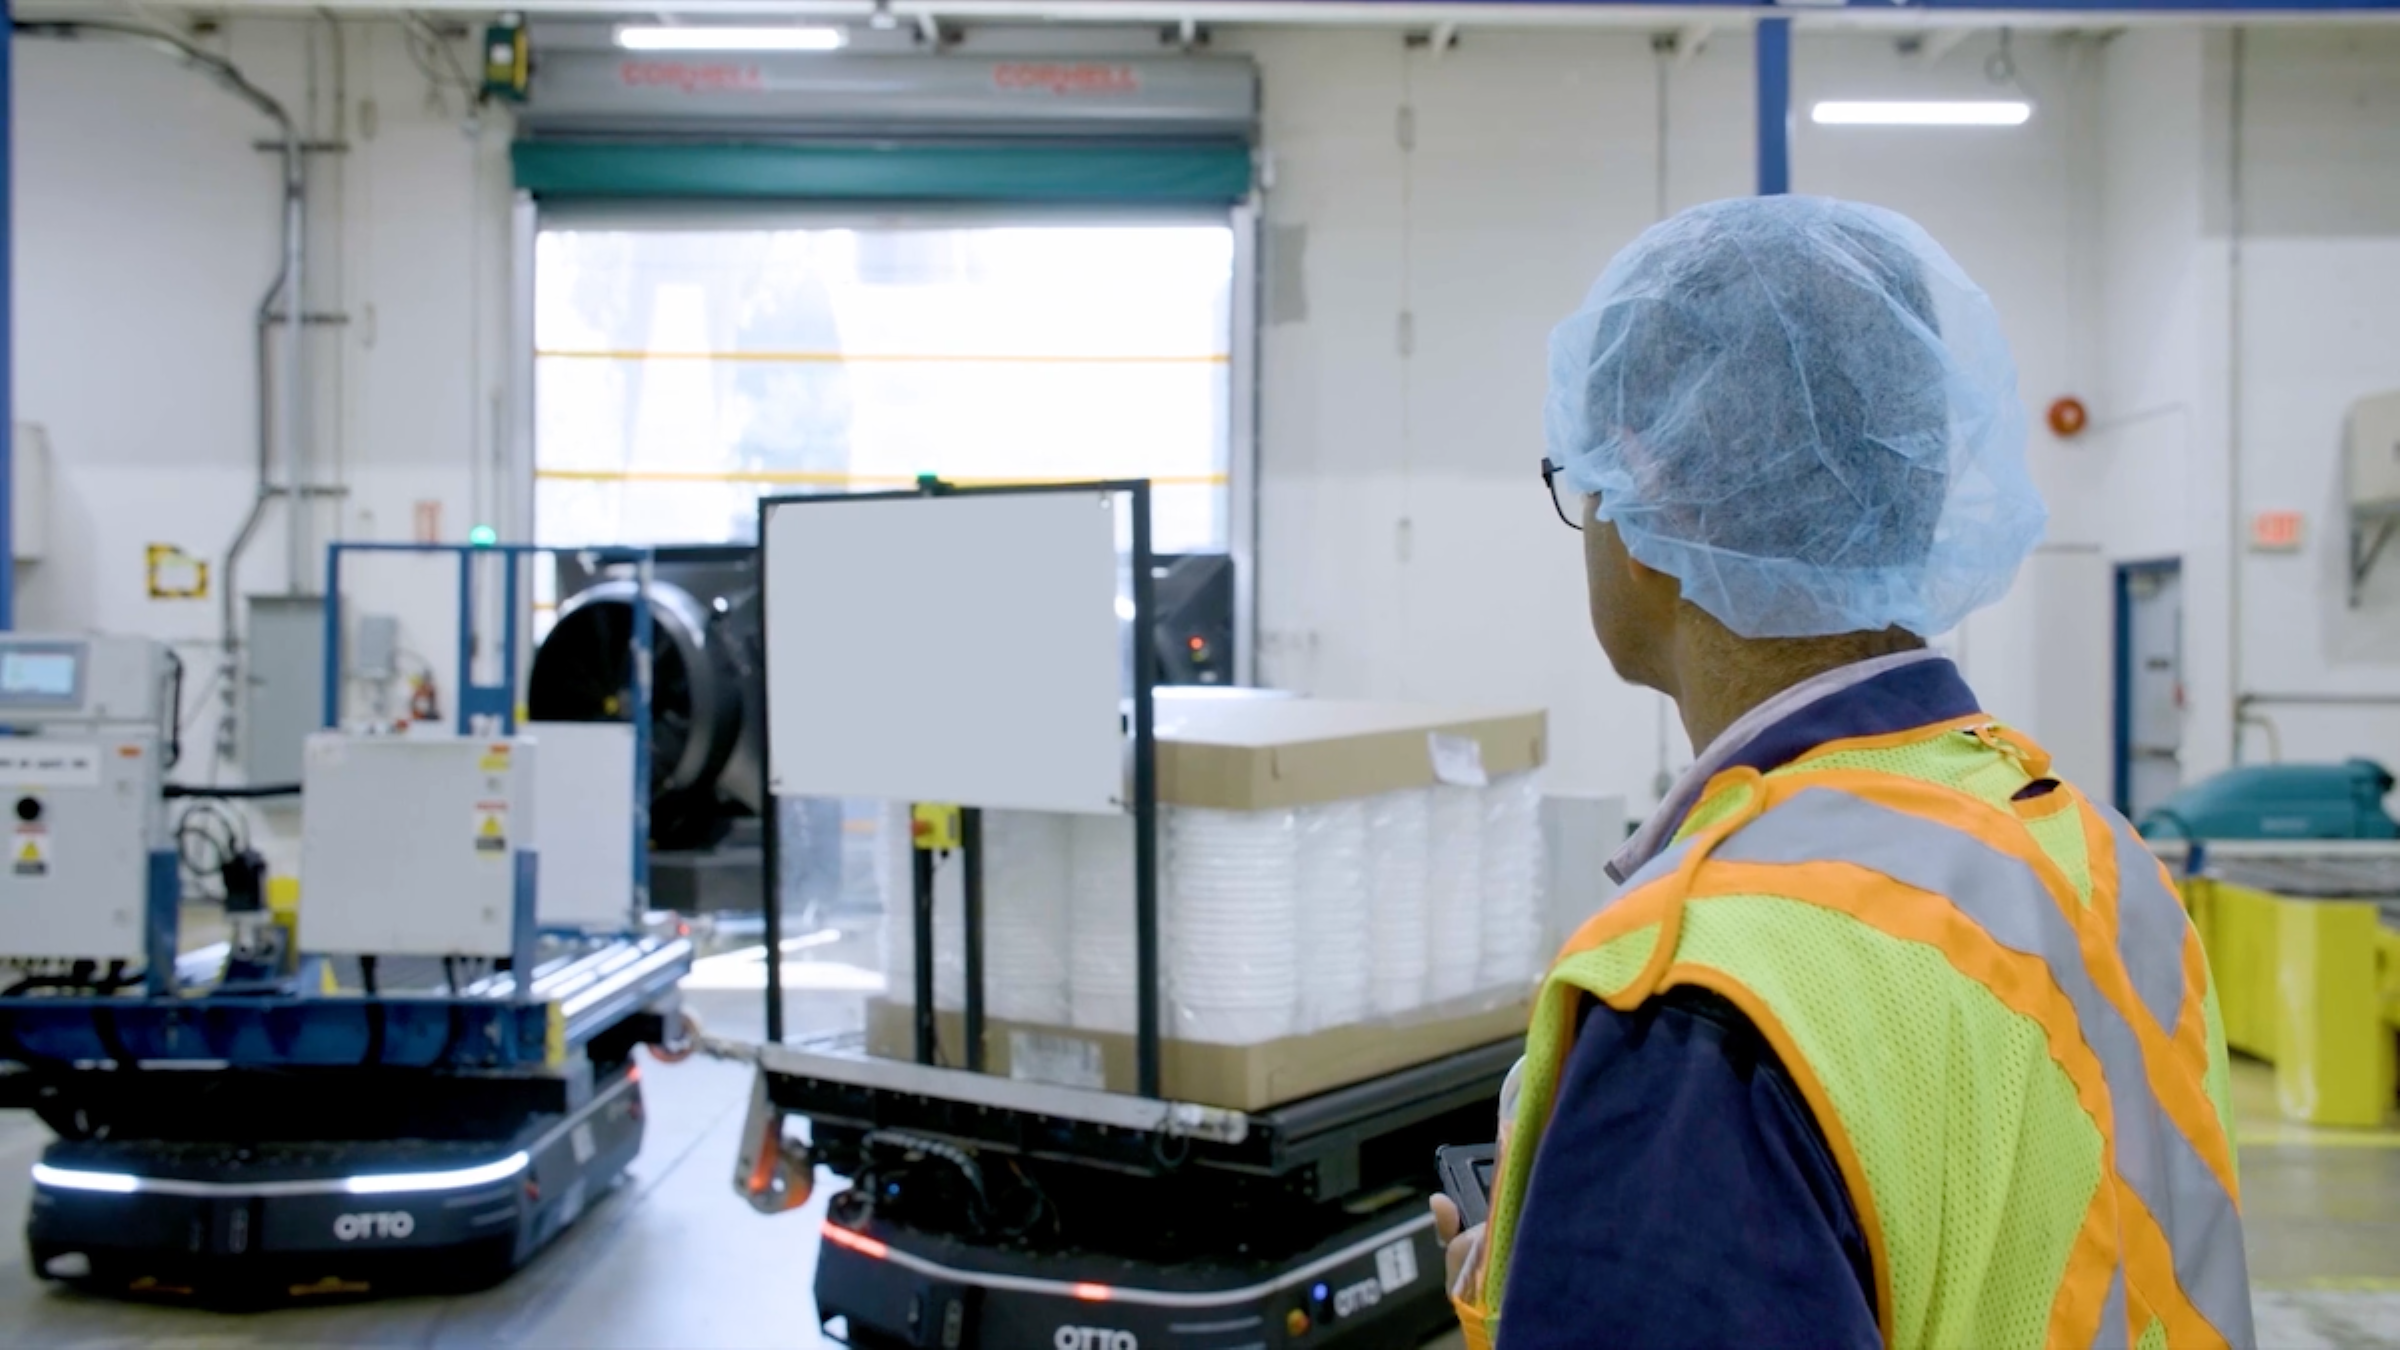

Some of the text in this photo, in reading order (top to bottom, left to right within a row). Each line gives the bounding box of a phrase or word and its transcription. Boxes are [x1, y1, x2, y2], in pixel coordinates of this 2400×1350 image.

[333, 1211, 415, 1241] OTTO
[1333, 1277, 1382, 1317] OTTO
[1053, 1325, 1138, 1350] OTTO
